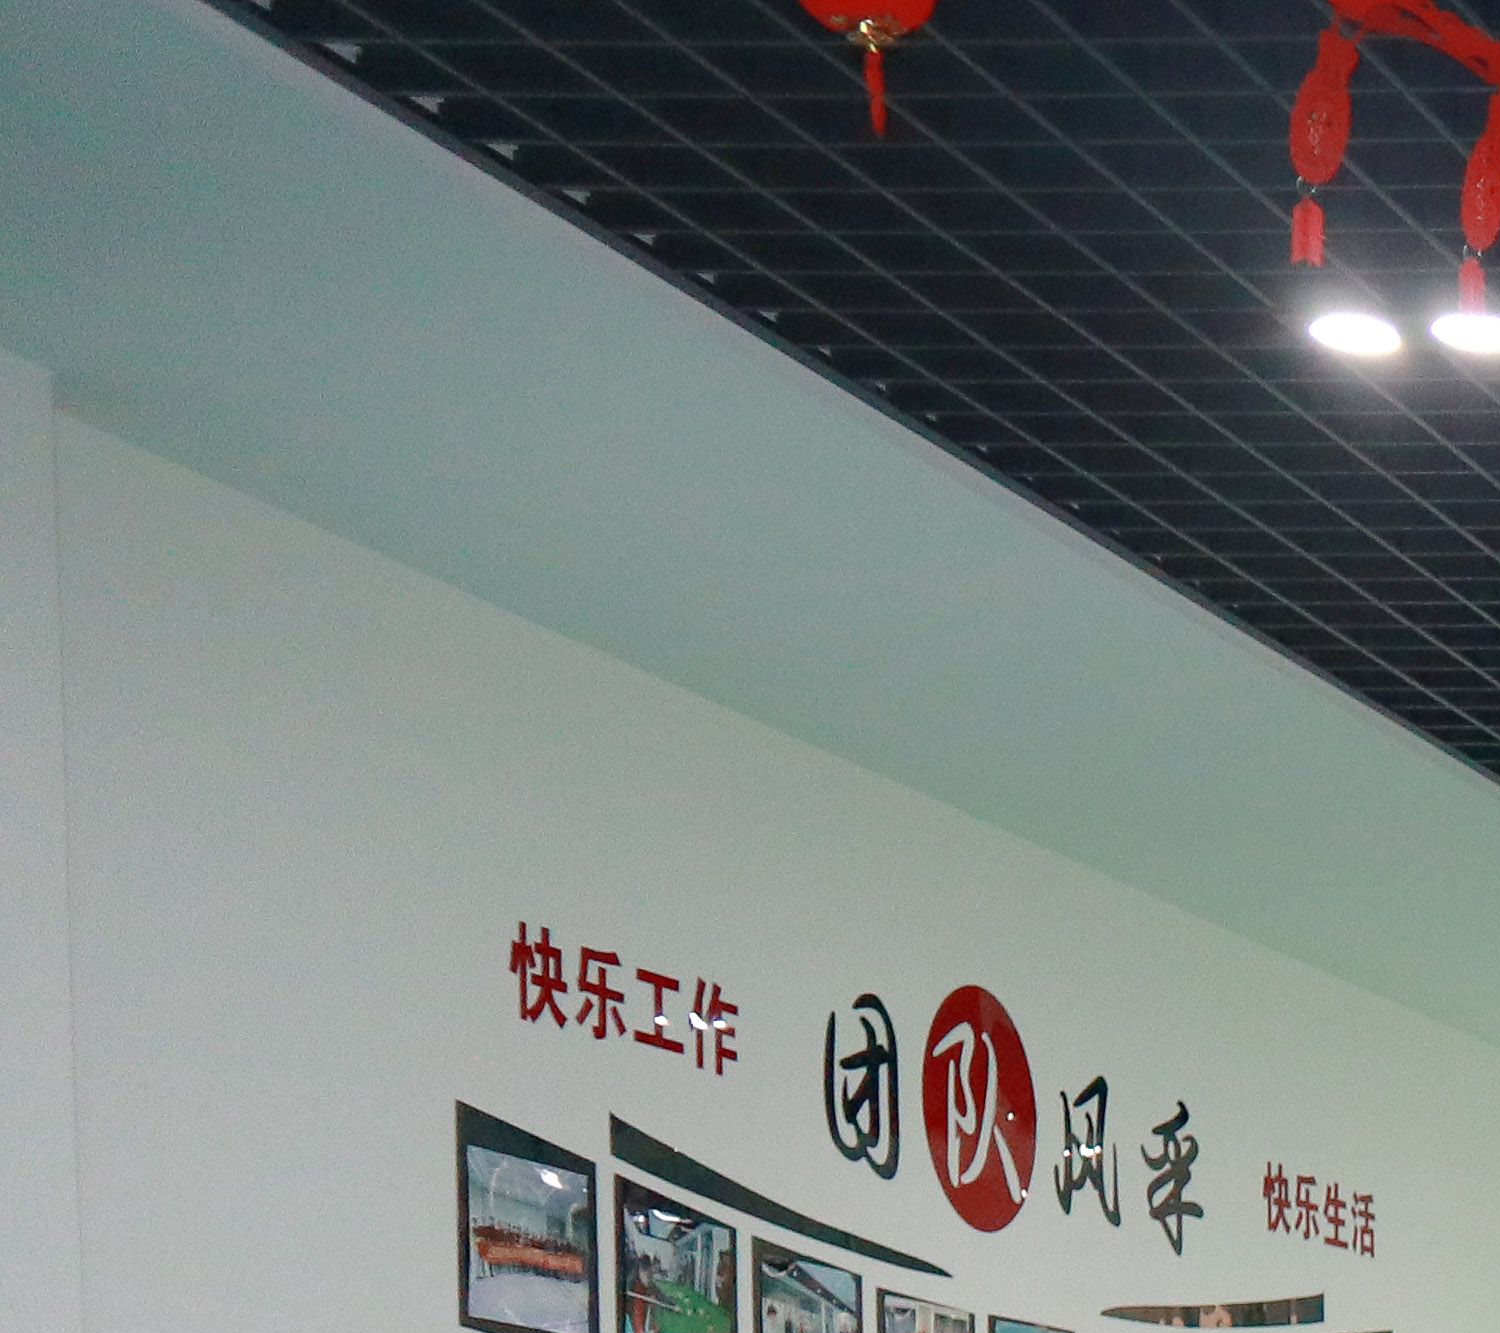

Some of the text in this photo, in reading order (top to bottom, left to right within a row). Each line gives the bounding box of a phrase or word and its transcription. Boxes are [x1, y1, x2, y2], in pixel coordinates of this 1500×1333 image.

[509, 921, 738, 1075] 快乐工作
[824, 993, 1204, 1256] 团队风采
[1263, 1161, 1376, 1258] 快乐生活
